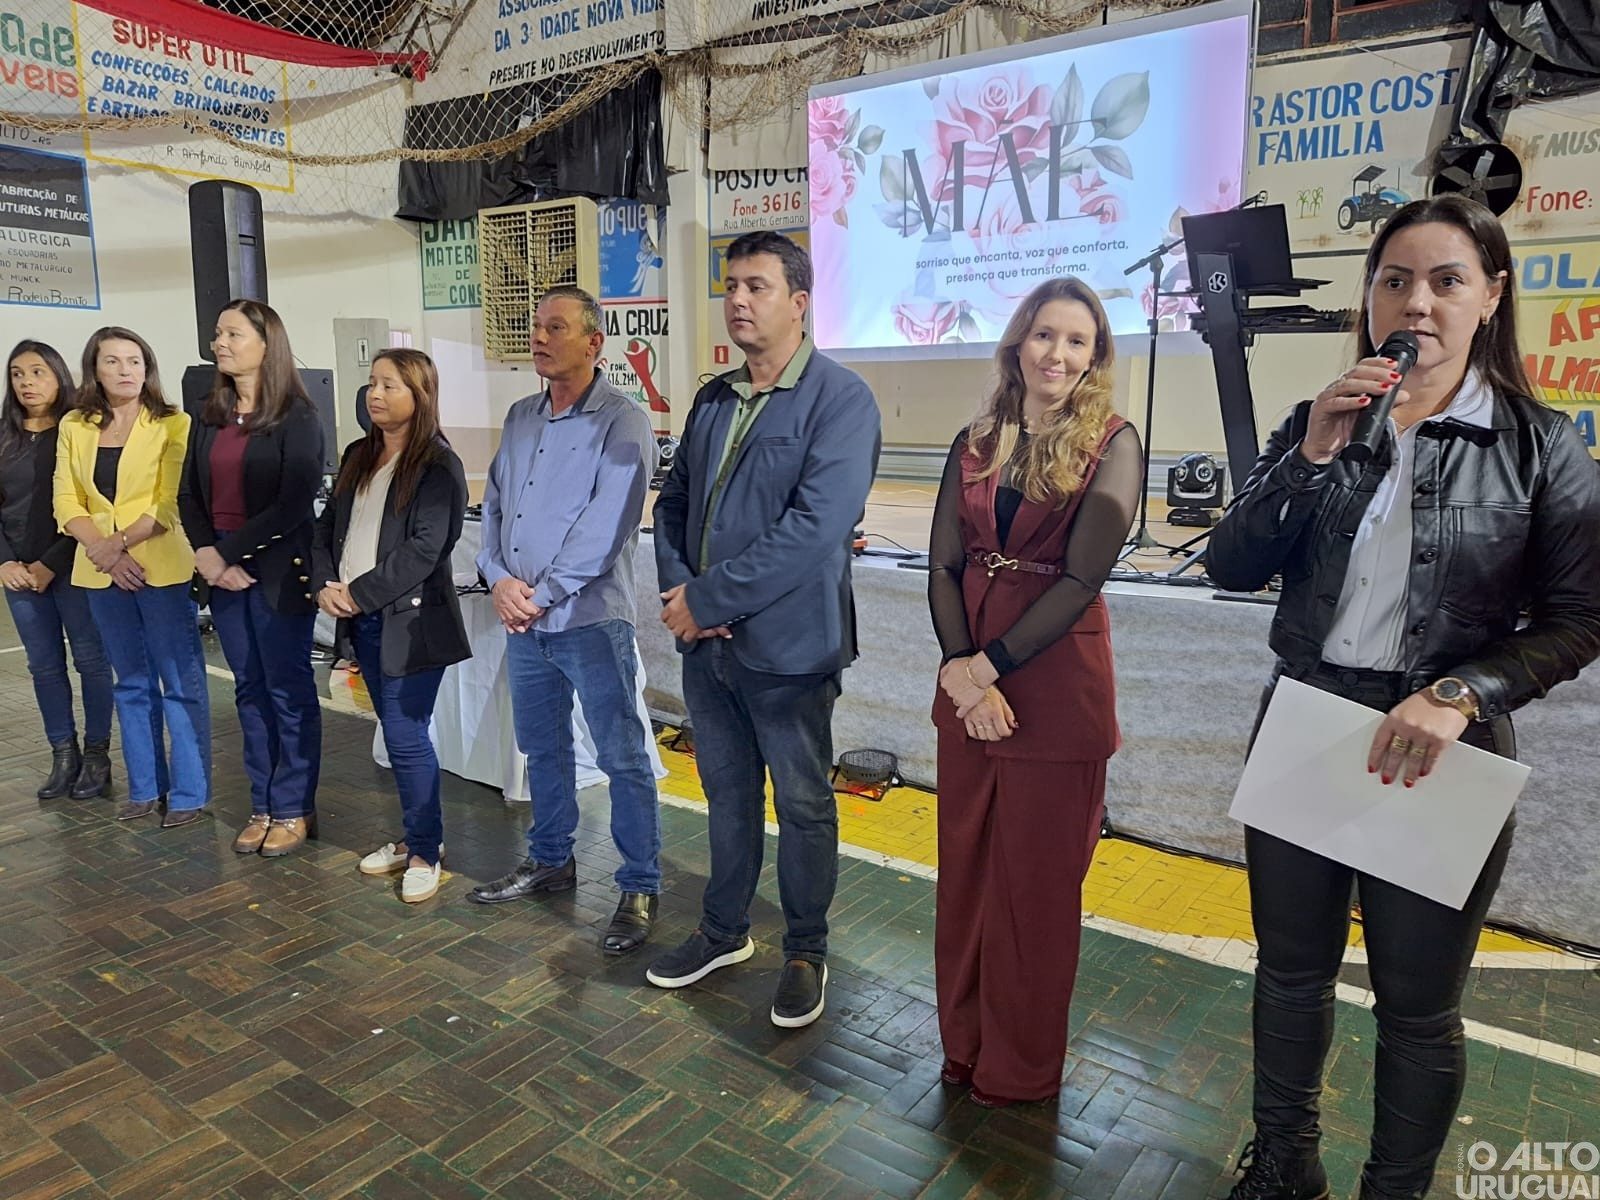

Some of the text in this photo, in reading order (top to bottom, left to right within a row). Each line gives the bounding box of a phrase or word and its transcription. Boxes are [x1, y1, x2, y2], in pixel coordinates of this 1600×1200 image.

[494, 28, 511, 52] DA
[540, 8, 581, 40] IDADE
[587, 0, 624, 28] NOVA
[112, 19, 193, 62] SUPER
[489, 29, 665, 86] PRESENTE NO DESENVOLVIMENTO
[102, 75, 160, 101] BAZAR
[173, 90, 270, 125] BRINQUEDOS
[204, 75, 276, 104] CALÇADOS
[1269, 81, 1363, 127] ASTOR
[1369, 67, 1461, 115] COST
[87, 96, 98, 113] E
[0, 124, 30, 140] LTO
[1257, 119, 1384, 166] FAMILIA
[1543, 127, 1600, 158] MUS
[784, 167, 809, 184] CR
[902, 118, 1107, 238] MÃE
[65, 193, 78, 204] DE
[733, 191, 802, 217] Fone 3616
[1526, 185, 1593, 213] Fone:
[44, 207, 89, 222] METÁLICAS
[723, 215, 805, 231] Rua Alberto Germano
[425, 244, 480, 267] MATERI
[915, 256, 950, 269] sorriso
[951, 256, 972, 268] que
[973, 250, 1023, 264] encanta,
[1025, 247, 1045, 259] voz
[1047, 245, 1069, 258] que
[455, 269, 470, 281] DE
[945, 261, 1090, 286] presença que transforma.
[1512, 252, 1600, 290] OL
[626, 308, 669, 336] CRUZ
[610, 363, 627, 371] FONE
